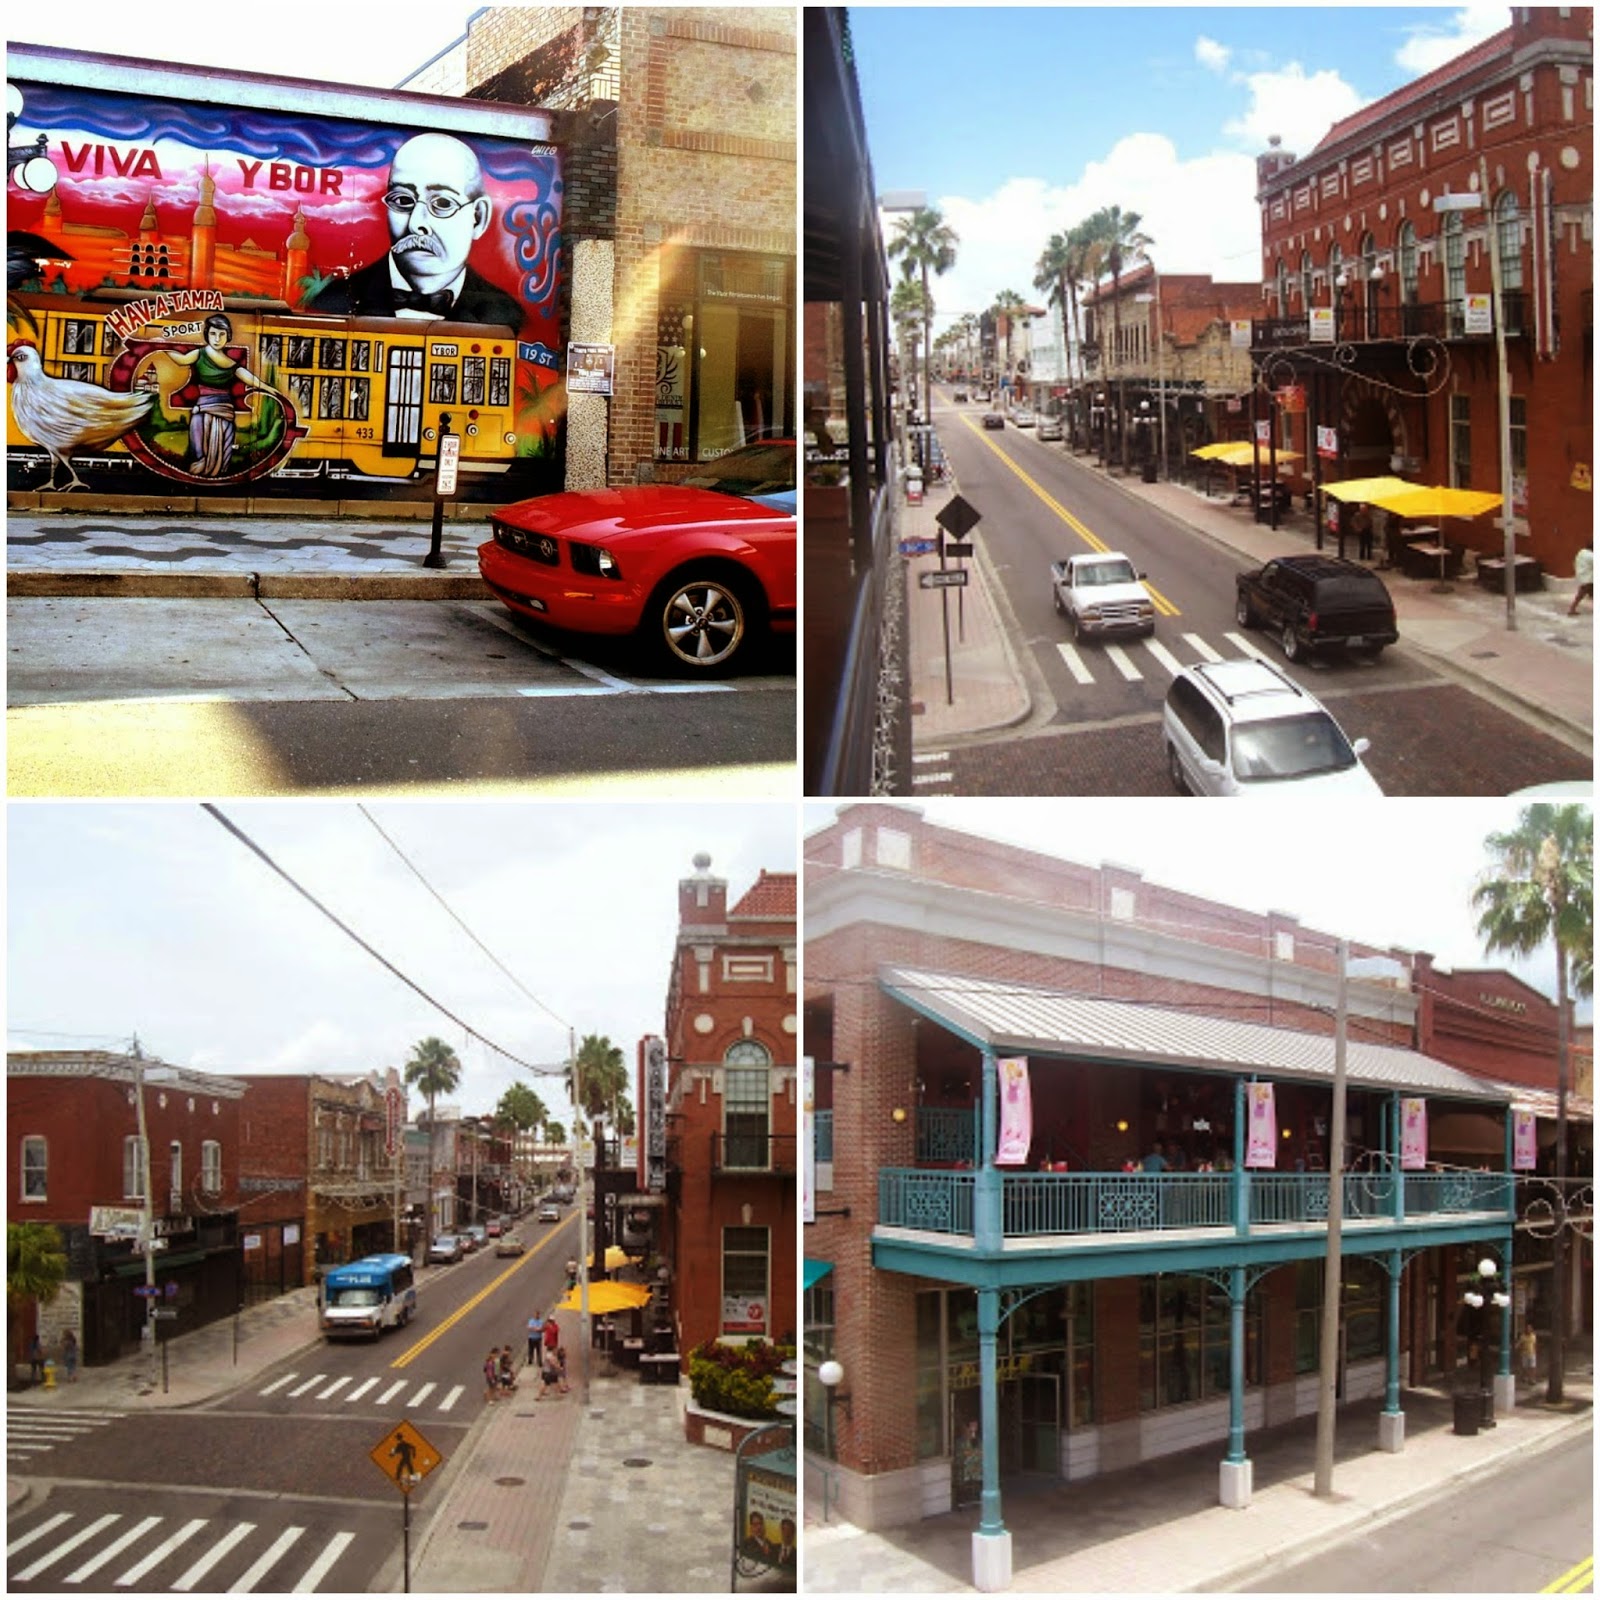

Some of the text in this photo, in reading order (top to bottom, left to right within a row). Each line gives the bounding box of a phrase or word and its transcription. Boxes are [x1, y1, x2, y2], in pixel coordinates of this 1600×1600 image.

[61, 141, 343, 196] VIVA YBOR
[163, 322, 203, 338] SPORT
[434, 346, 455, 356] YBOR
[525, 348, 553, 366] 19 ST
[356, 427, 374, 439] 433
[672, 447, 690, 457] ART
